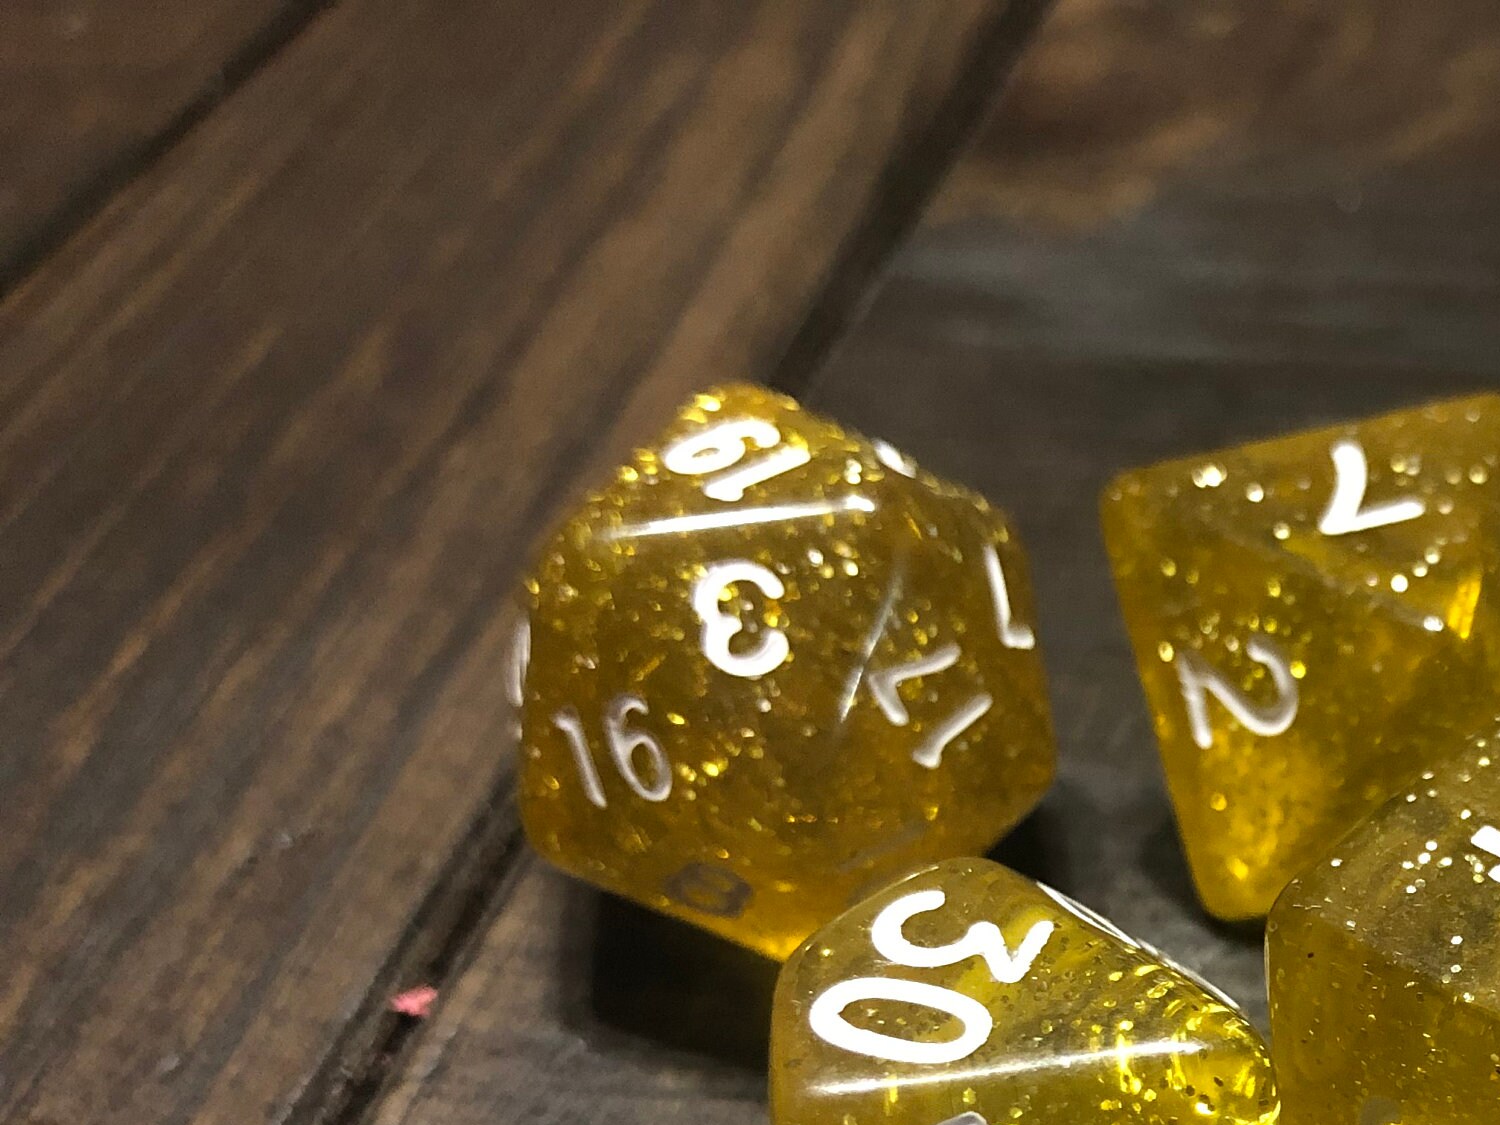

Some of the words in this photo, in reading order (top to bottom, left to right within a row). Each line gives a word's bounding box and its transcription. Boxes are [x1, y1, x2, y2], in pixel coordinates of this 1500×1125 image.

[661, 417, 812, 502] 19
[1318, 440, 1427, 536] 7
[693, 558, 790, 678] 3
[1176, 633, 1300, 750] 2
[551, 693, 673, 808] 16
[809, 889, 1055, 1064] 30
